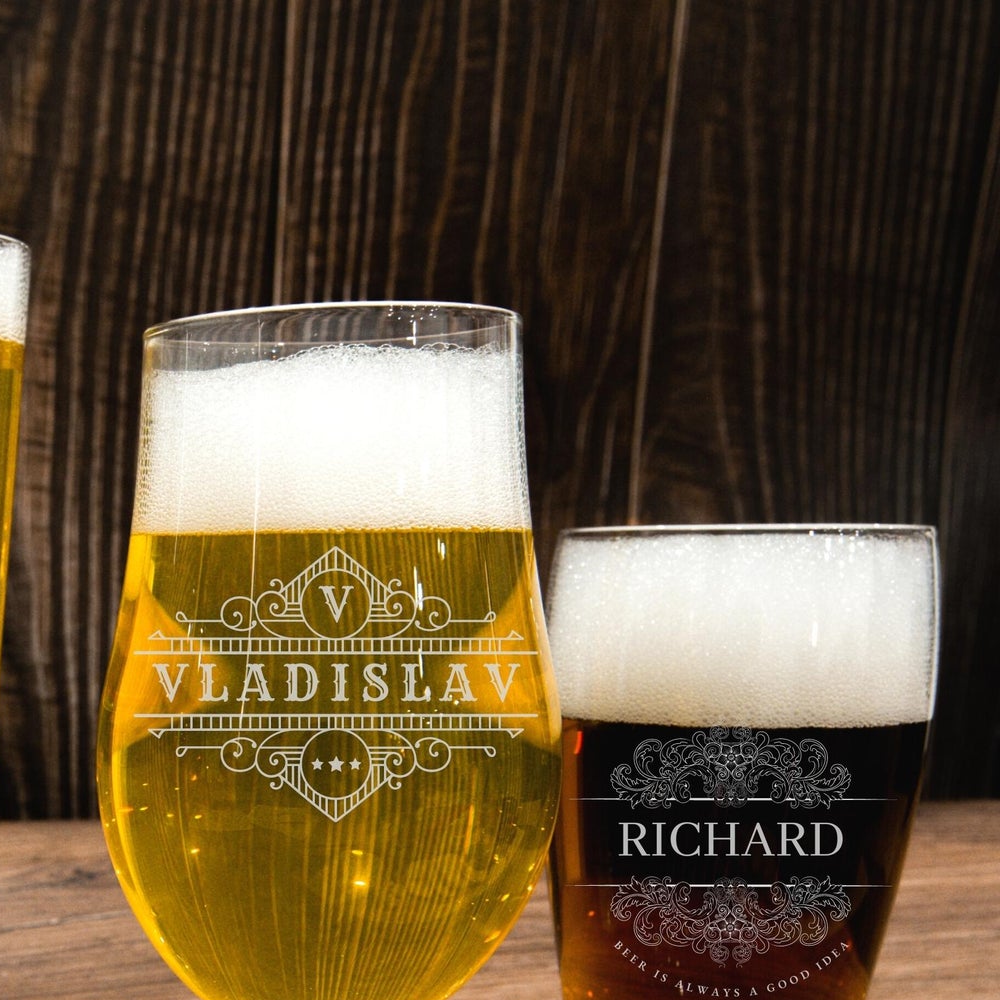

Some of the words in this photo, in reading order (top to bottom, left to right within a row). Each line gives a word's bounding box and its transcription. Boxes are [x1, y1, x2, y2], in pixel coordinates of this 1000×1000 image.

[319, 586, 354, 624] V
[151, 663, 521, 703] VLADISLAV
[618, 821, 844, 857] RICHARD
[614, 940, 647, 972] BEER
[653, 970, 669, 983] IS
[674, 979, 740, 997] ALWAYS
[749, 987, 758, 997] A
[766, 970, 810, 992] GOOD
[815, 941, 850, 970] IDEA
